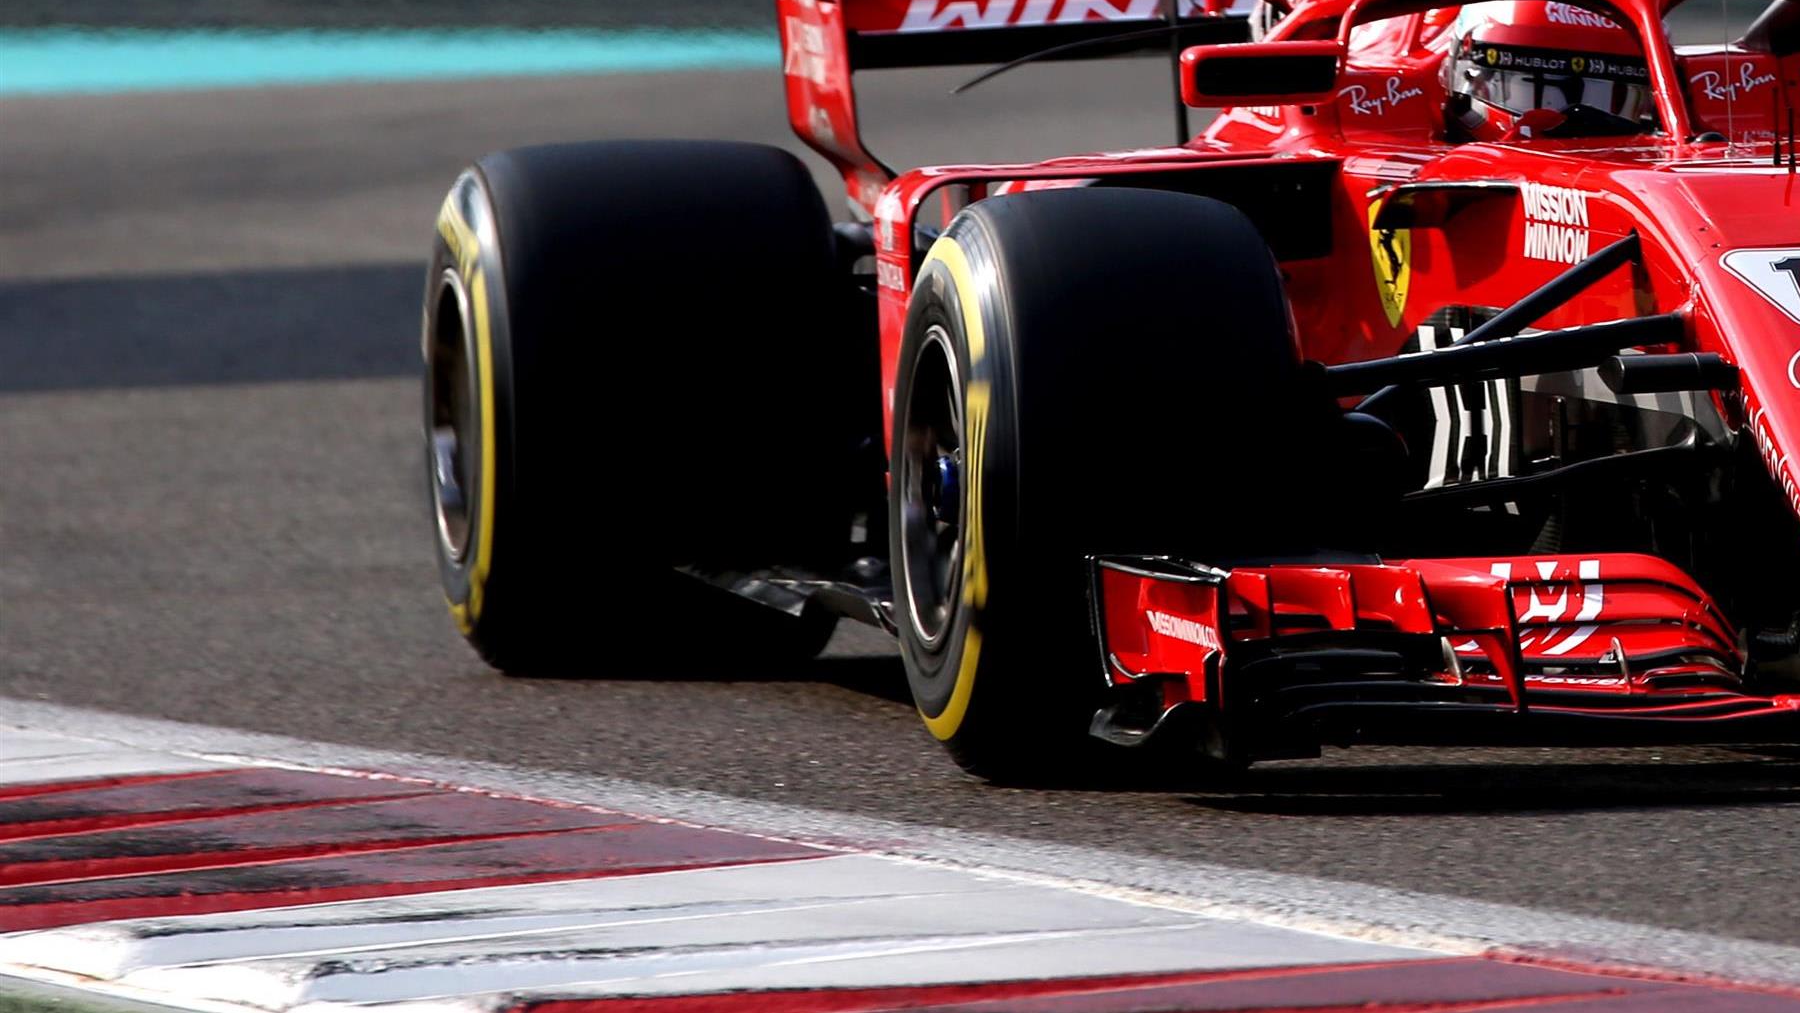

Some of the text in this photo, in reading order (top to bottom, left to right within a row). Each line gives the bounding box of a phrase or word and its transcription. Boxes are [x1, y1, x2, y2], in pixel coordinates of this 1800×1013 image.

[1515, 57, 1567, 70] HUBLOT
[1607, 64, 1648, 77] HUBLO
[1690, 62, 1776, 101] Ray-Ban
[1336, 76, 1423, 116] Ray-Ban
[1520, 181, 1589, 228] MISSION
[1524, 221, 1589, 265] WINNOW
